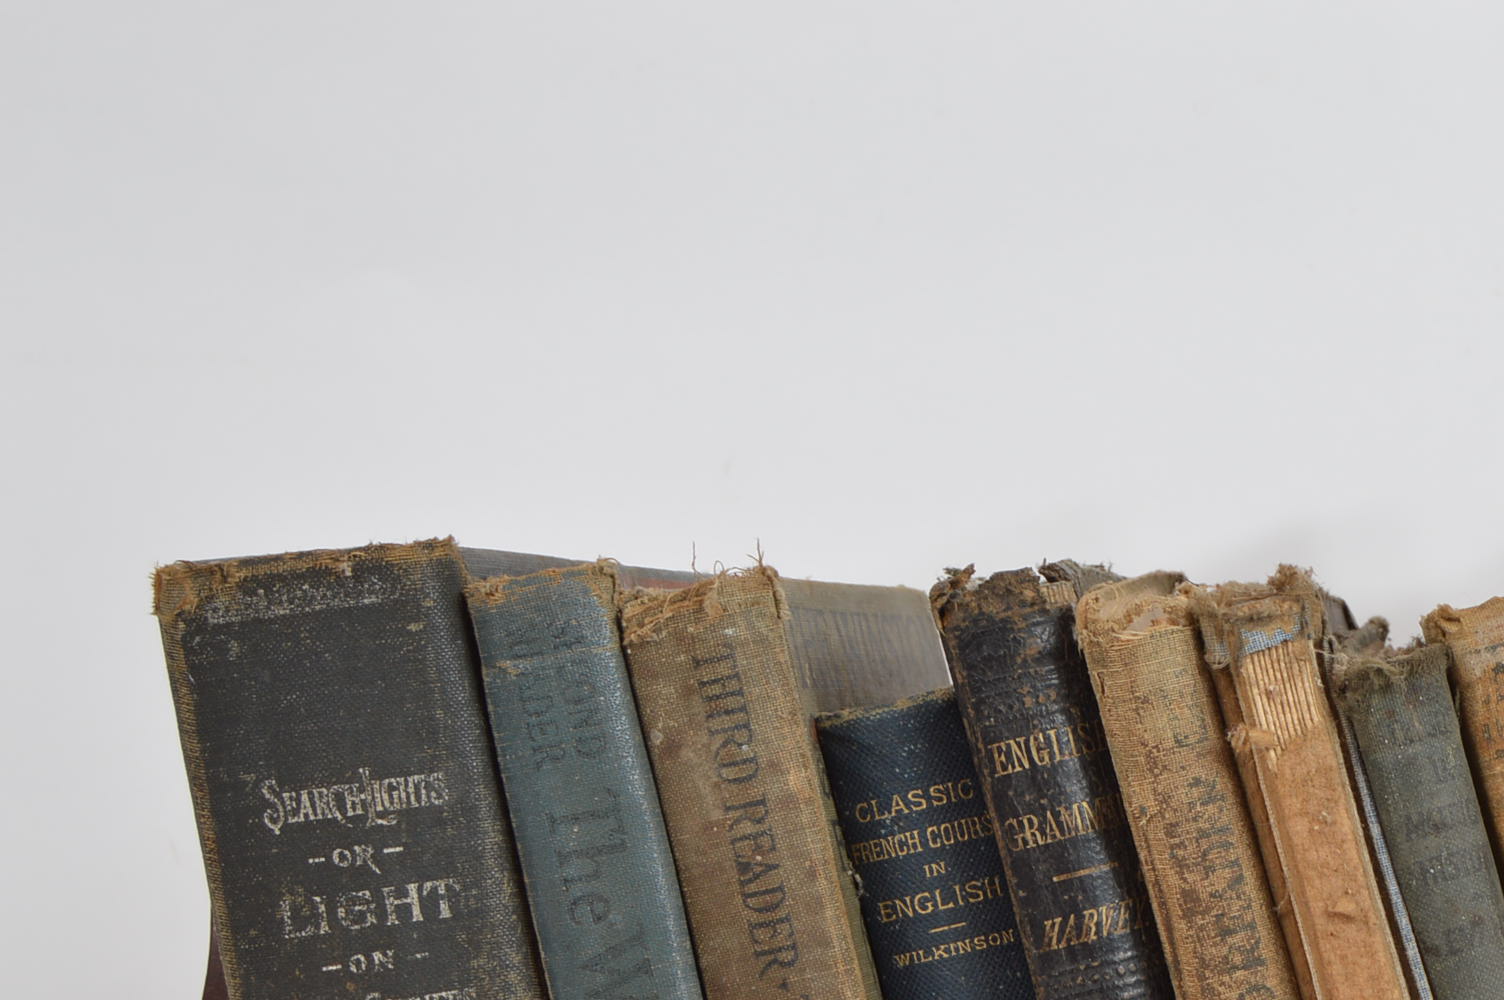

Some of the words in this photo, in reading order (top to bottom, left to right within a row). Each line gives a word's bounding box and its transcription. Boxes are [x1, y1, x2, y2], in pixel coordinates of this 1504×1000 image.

[693, 647, 758, 786] THIRD
[855, 779, 973, 822] CLASSIC
[332, 845, 381, 874] OR
[545, 791, 627, 927] The
[851, 831, 923, 865] FRENCH
[923, 861, 947, 877] IN
[723, 795, 798, 975] READER
[878, 876, 1001, 923] ENGLISH
[281, 877, 462, 940] LIGHT
[895, 929, 1014, 967] WILKINSON
